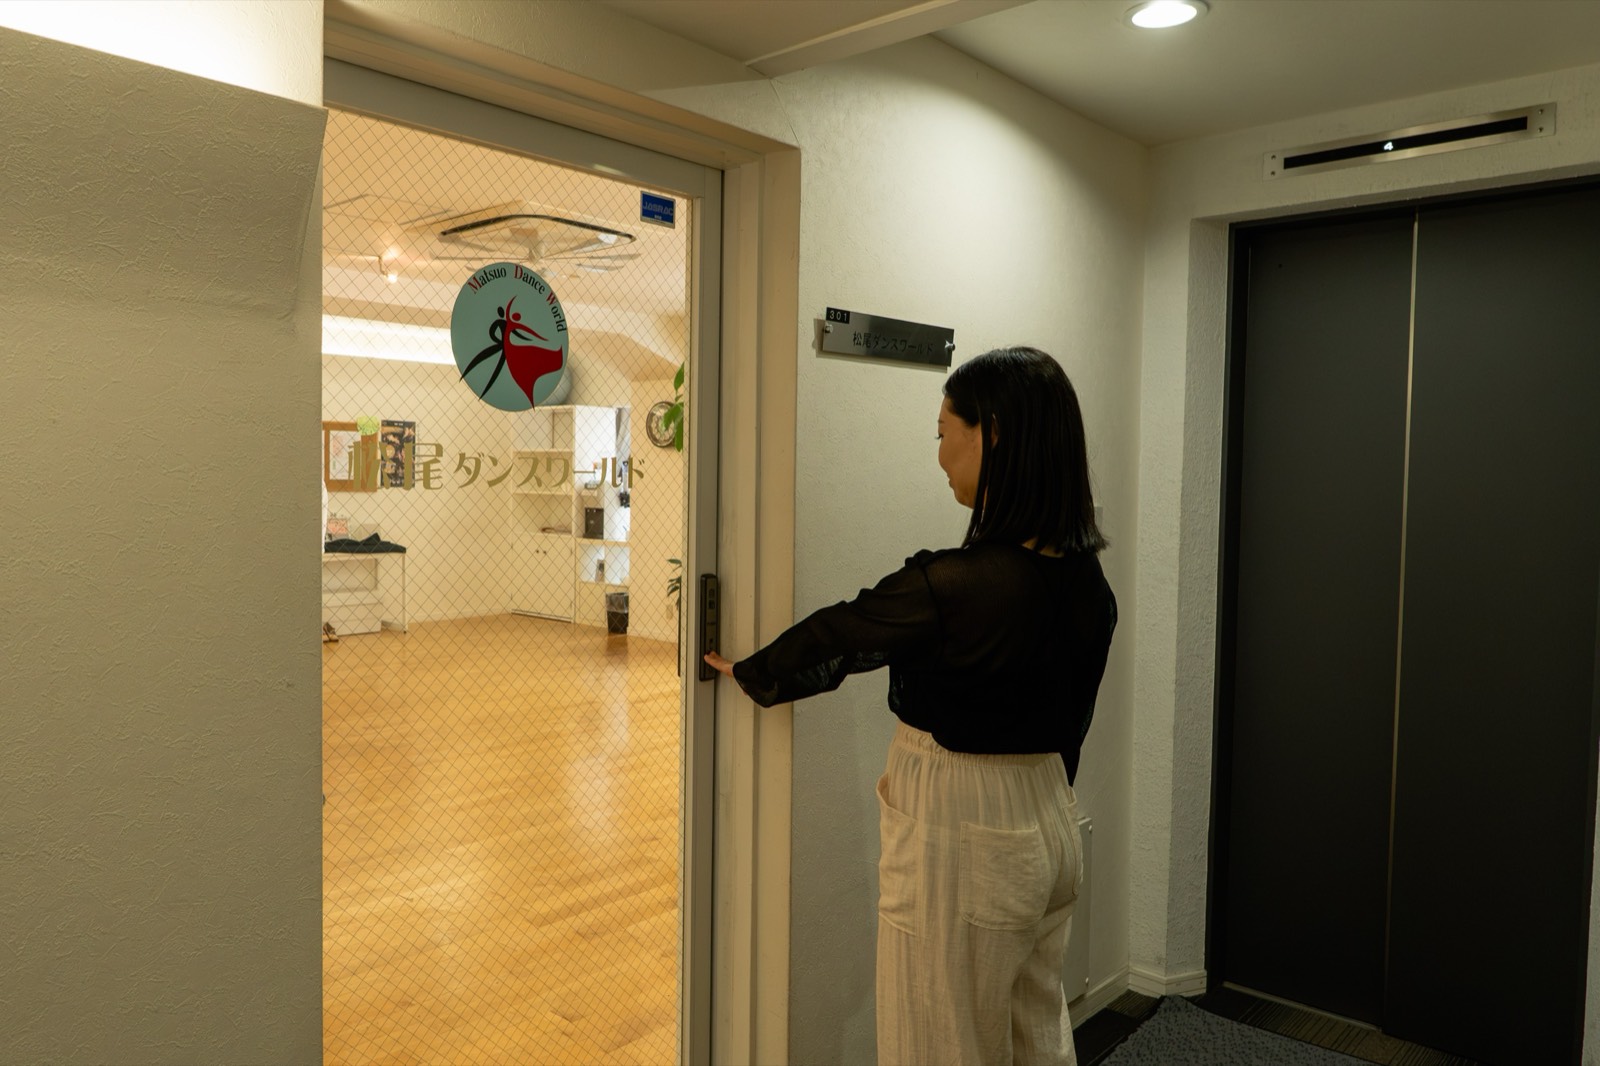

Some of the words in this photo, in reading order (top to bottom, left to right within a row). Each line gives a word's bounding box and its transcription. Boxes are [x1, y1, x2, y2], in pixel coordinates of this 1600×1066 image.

[1383, 141, 1394, 151] 4
[467, 266, 507, 294] Matsuo
[513, 264, 546, 295] Dance
[545, 290, 567, 333] World
[829, 310, 848, 322] 301
[852, 331, 935, 355] 松尾ダンスワールド
